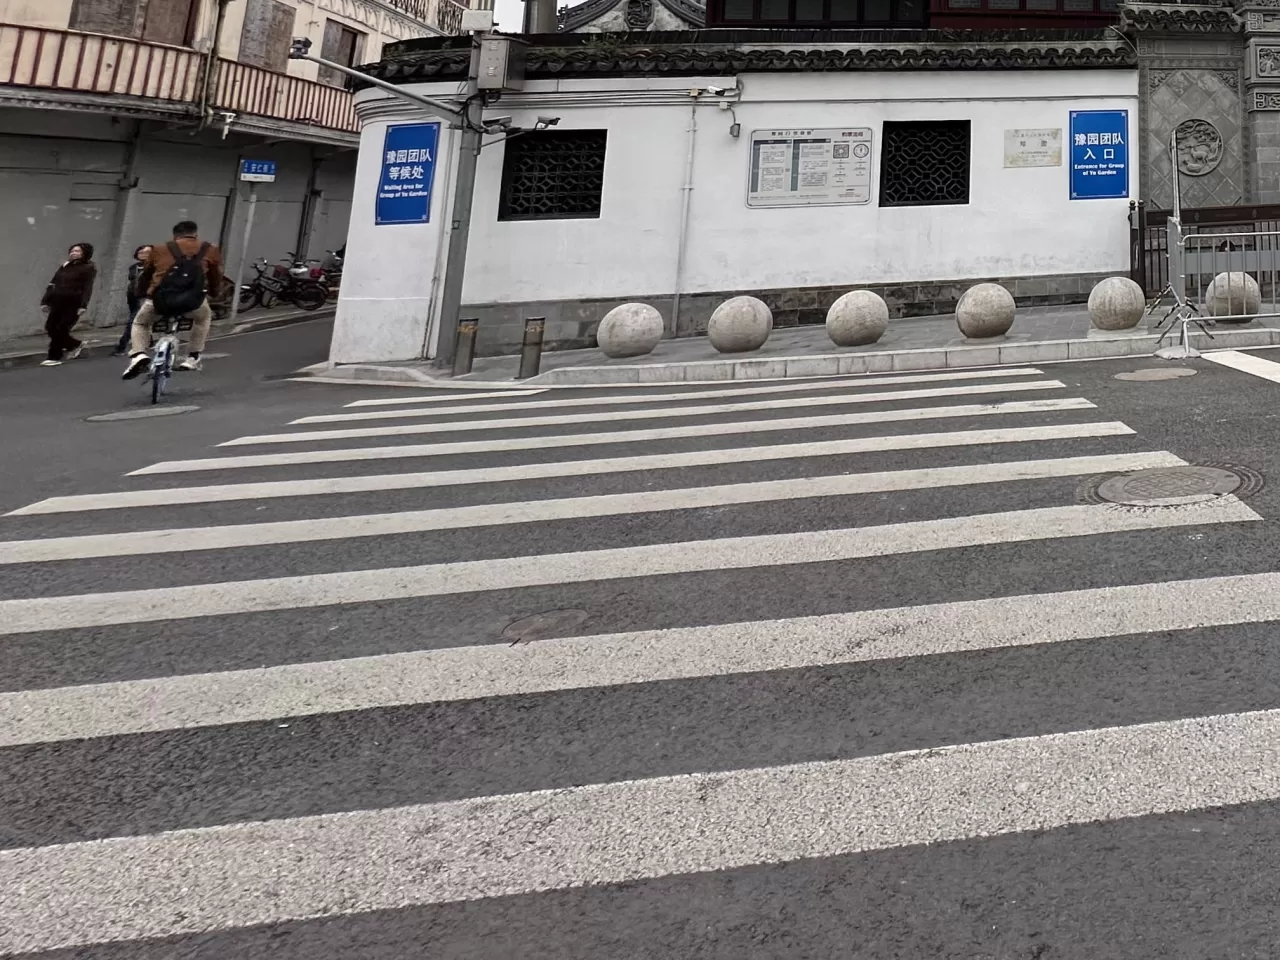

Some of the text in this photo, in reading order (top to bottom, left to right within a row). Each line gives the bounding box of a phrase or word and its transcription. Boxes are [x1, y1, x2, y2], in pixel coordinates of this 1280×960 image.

[1075, 132, 1124, 146] 豫园团队
[386, 148, 432, 164] 豫园团队
[1084, 148, 1114, 159] 入口
[389, 166, 424, 180] 等候处
